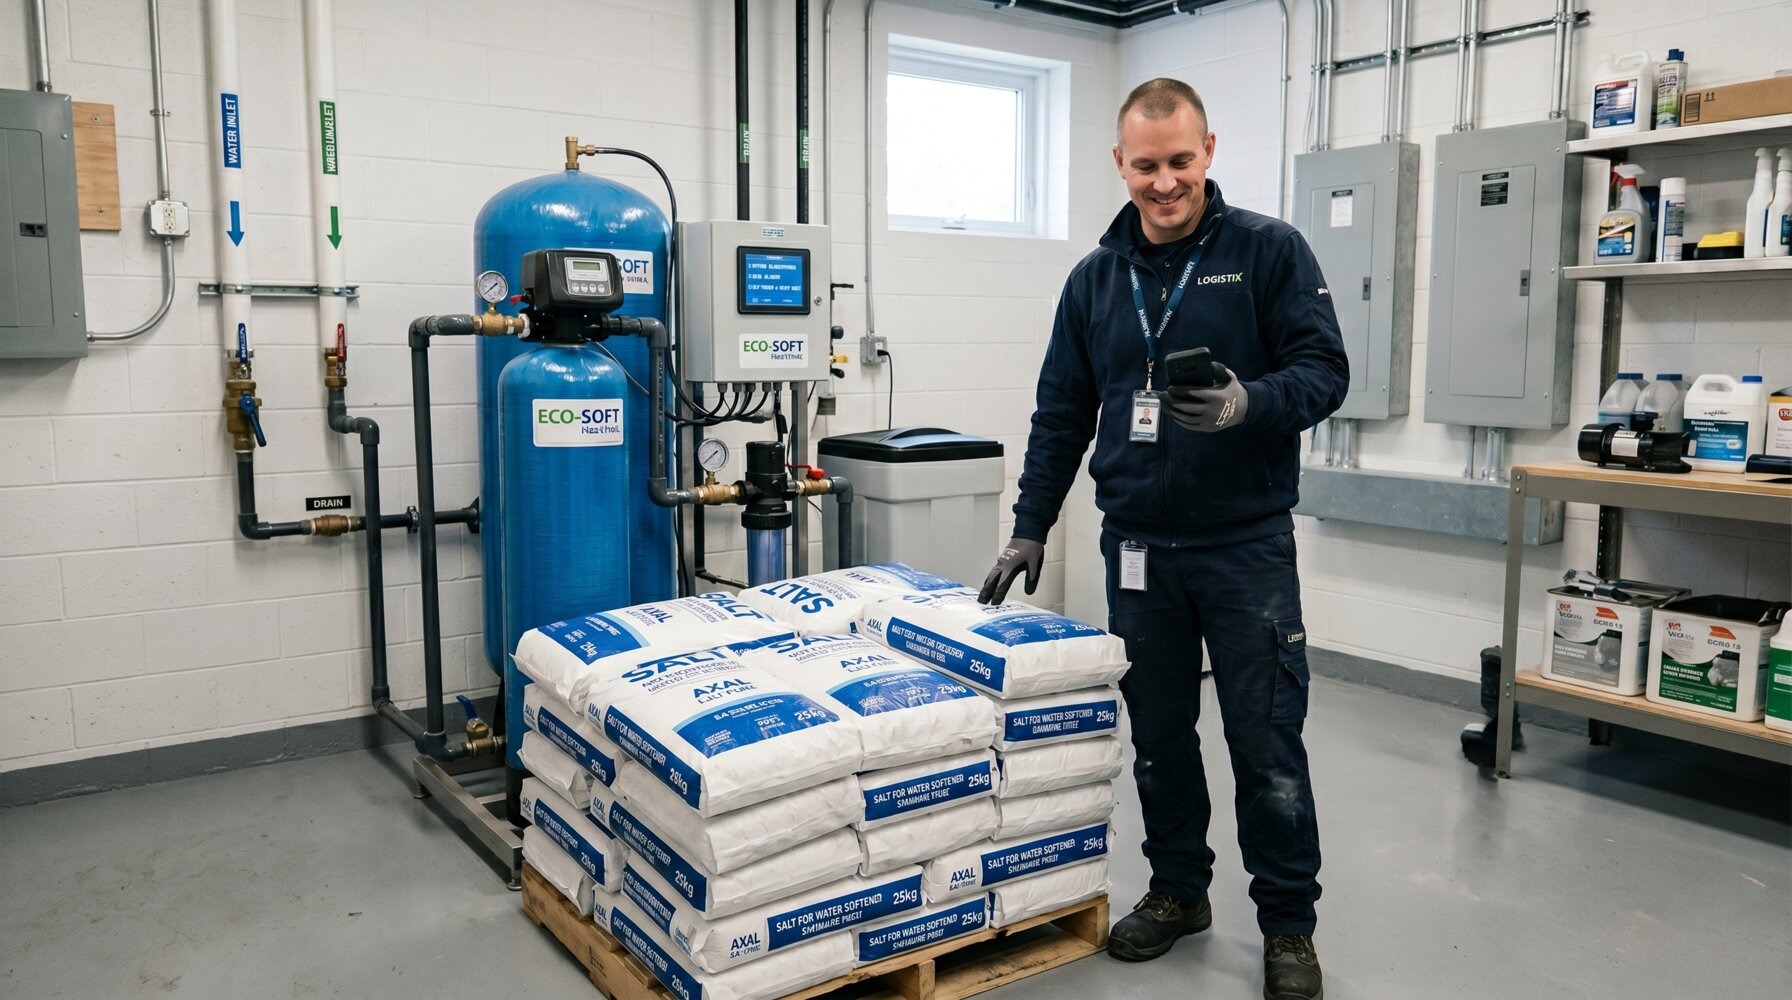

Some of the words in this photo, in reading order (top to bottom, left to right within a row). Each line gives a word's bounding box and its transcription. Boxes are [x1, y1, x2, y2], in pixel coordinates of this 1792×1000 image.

[225, 98, 237, 128] INLET
[227, 130, 238, 164] WATER
[1197, 272, 1243, 285] LOGISTIX
[743, 340, 804, 352] ECO-SOFT
[538, 409, 620, 424] ECO-SOFT
[313, 498, 343, 508] DRAIN
[697, 593, 764, 619] SALT
[760, 583, 834, 614] SALT
[640, 607, 673, 623] AXAL
[867, 618, 882, 632] AXAL
[621, 649, 728, 683] SALT
[840, 654, 893, 668] AXAL
[969, 659, 991, 680] 25kg
[693, 678, 753, 699] AXAL
[794, 708, 827, 721] 25kg
[1013, 716, 1028, 727] SALT
[1096, 710, 1115, 723] 25kg
[591, 759, 606, 782] 25kg
[873, 791, 891, 804] SALT
[892, 789, 906, 799] FOR
[907, 784, 930, 795] WATER
[931, 773, 964, 790] SOFTENER
[968, 773, 990, 788] 25kg
[987, 857, 1006, 870] SALT
[1005, 854, 1020, 865] FOR
[1020, 848, 1043, 861] WATER
[1043, 838, 1076, 854] SOFTENER
[1083, 837, 1104, 852] 25kg
[950, 867, 976, 883] AXAL
[776, 918, 796, 933] SALT
[797, 913, 814, 926] FOR
[815, 905, 843, 921] WATER
[893, 888, 918, 905] 25kg
[869, 935, 887, 947] SALT
[887, 931, 901, 942] FOR
[902, 924, 926, 937] WATER
[961, 911, 983, 926] 25kg
[731, 932, 761, 951] AXAL
